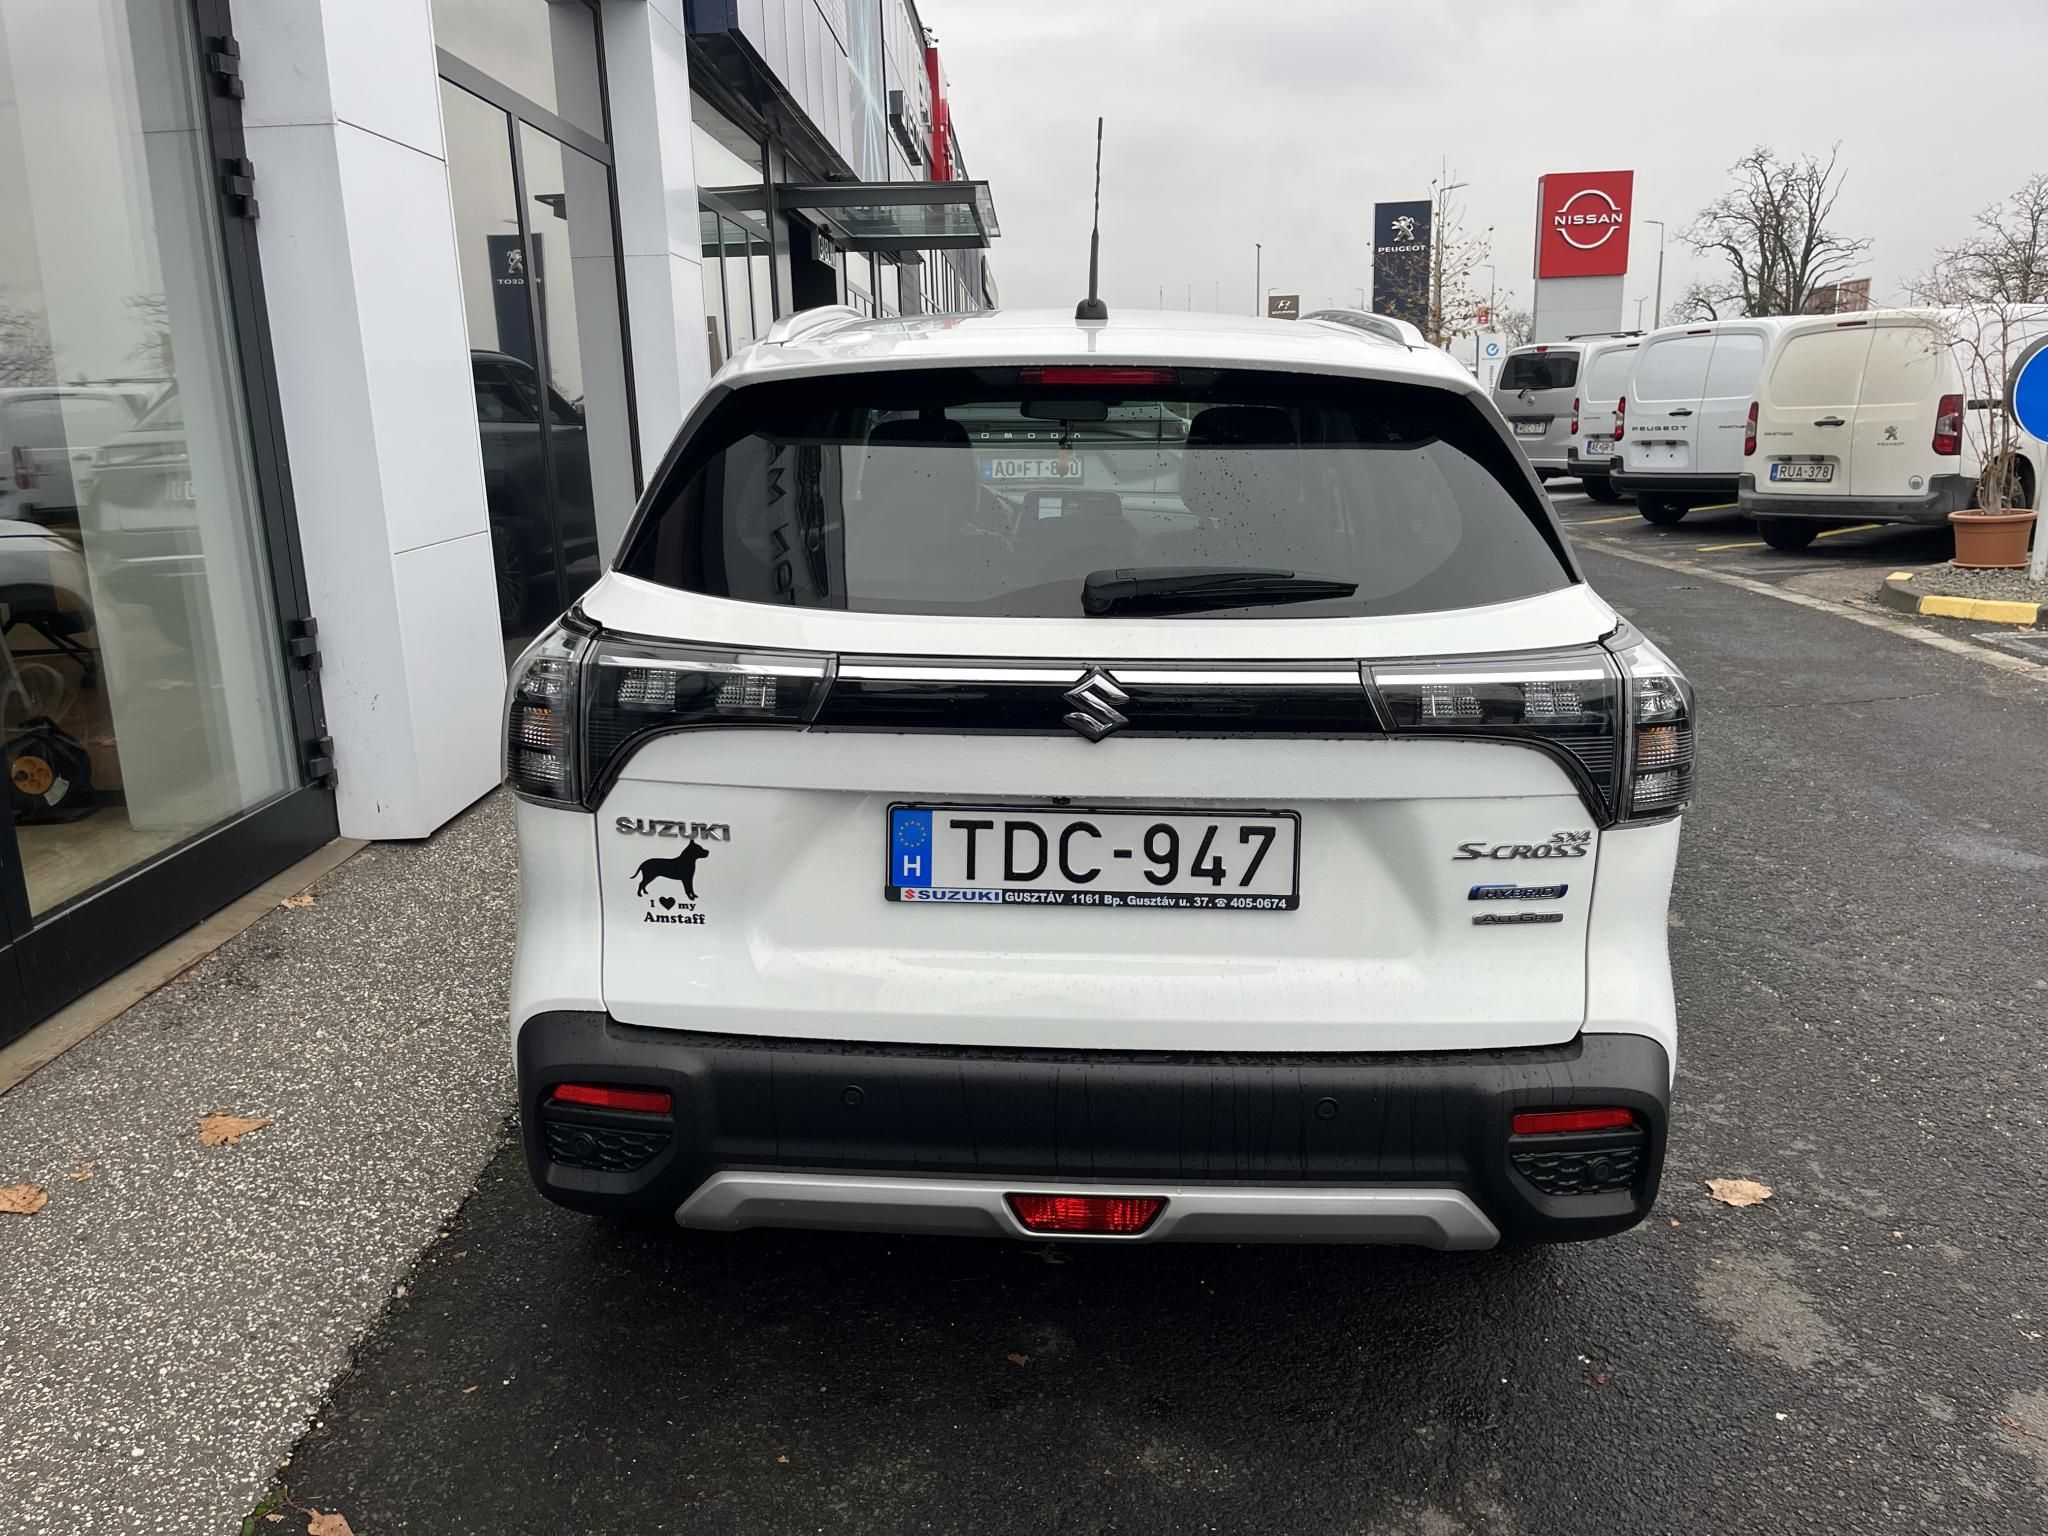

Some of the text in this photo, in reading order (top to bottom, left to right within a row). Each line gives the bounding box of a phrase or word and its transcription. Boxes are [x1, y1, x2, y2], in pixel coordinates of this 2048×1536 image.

[1554, 212, 1623, 226] NISSAN
[1378, 245, 1427, 253] PEUGEOT
[1778, 465, 1829, 478] RUA-378
[615, 816, 731, 842] SUZUKI
[1548, 830, 1592, 842] SX4
[903, 819, 1277, 887] H TDC-947
[1452, 842, 1591, 860] S-CROSS
[917, 889, 1287, 909] SUZUKI GUSZTÁV 1161 Bp. Gusztáv u. 37. 405-0674
[1483, 887, 1556, 899] HYBRID
[649, 899, 697, 912] I my
[643, 911, 706, 925] Amstaff
